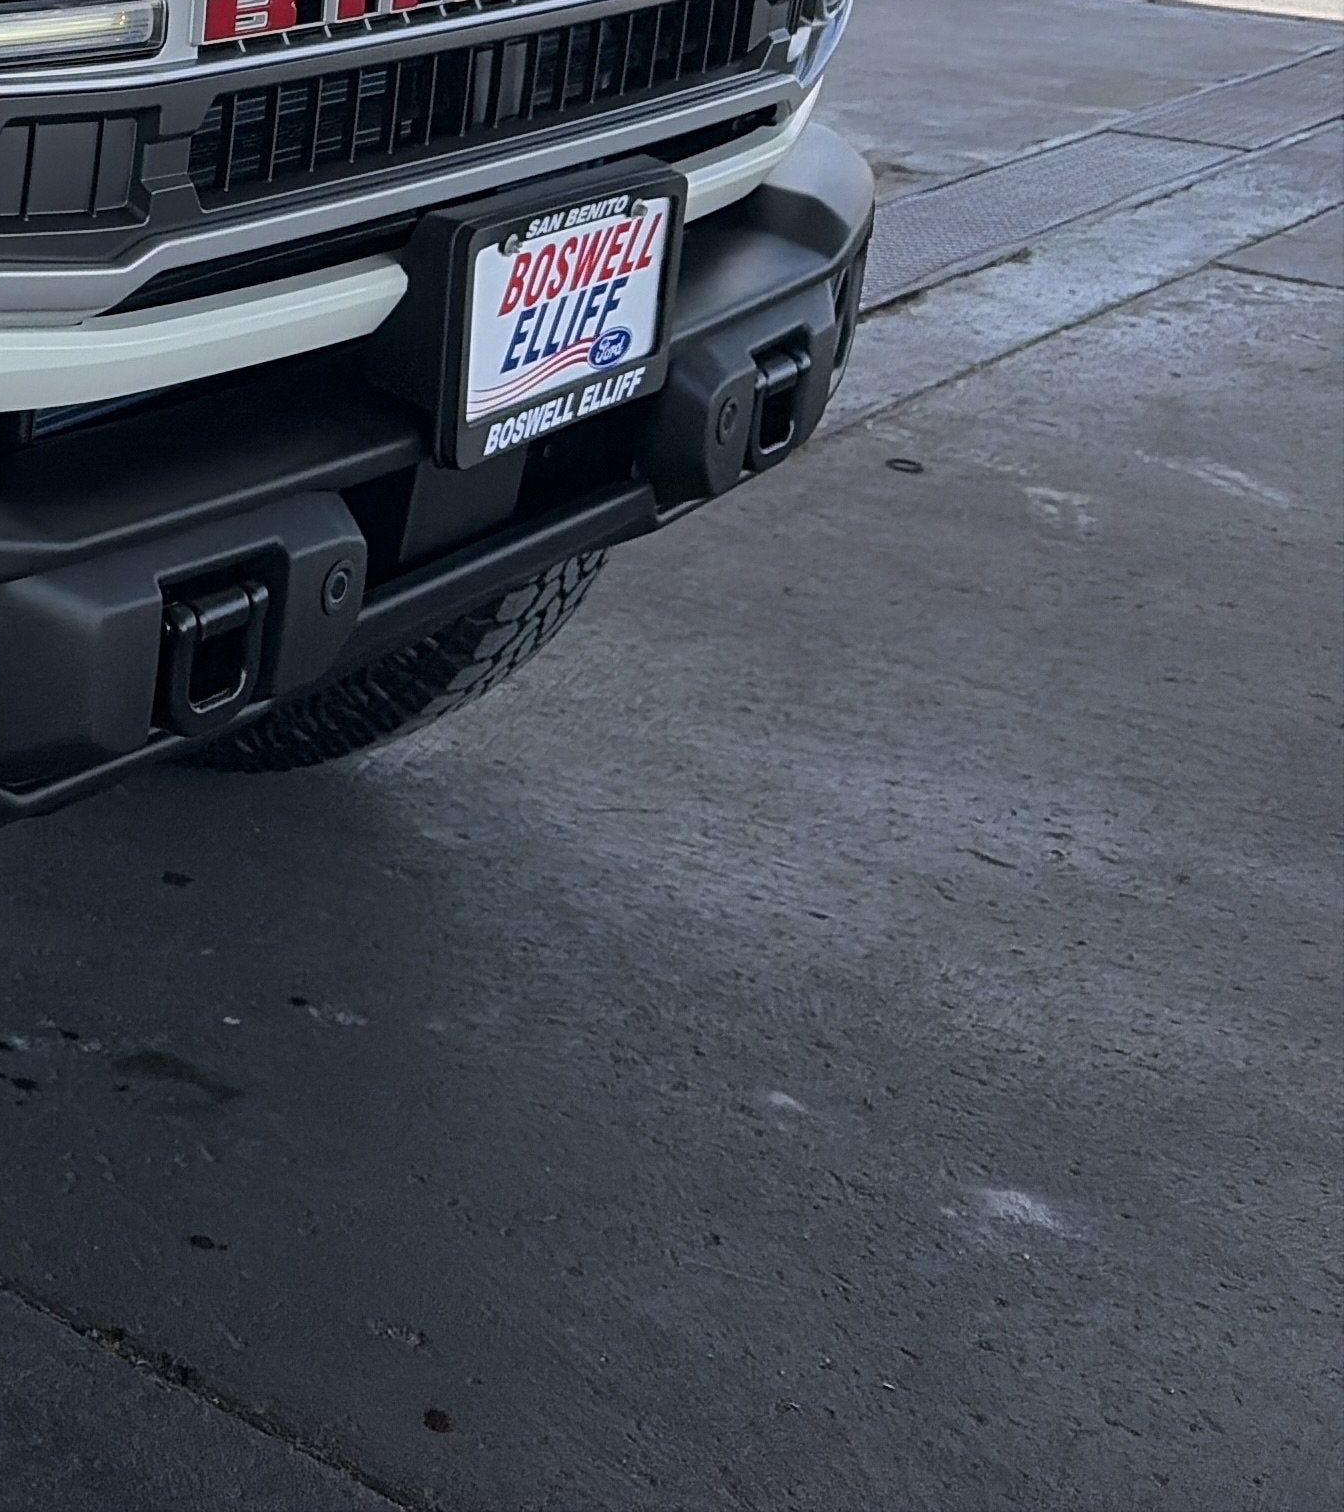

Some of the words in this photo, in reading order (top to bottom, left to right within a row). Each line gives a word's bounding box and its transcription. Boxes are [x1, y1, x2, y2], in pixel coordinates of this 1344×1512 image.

[525, 214, 562, 239] SAN
[564, 195, 630, 229] BENITO
[497, 212, 663, 317] BOSWELL
[500, 276, 628, 374] ELLIFF
[593, 333, 628, 365] Ford
[483, 399, 575, 456] BOSWELL
[577, 367, 646, 412] ELLIFF
